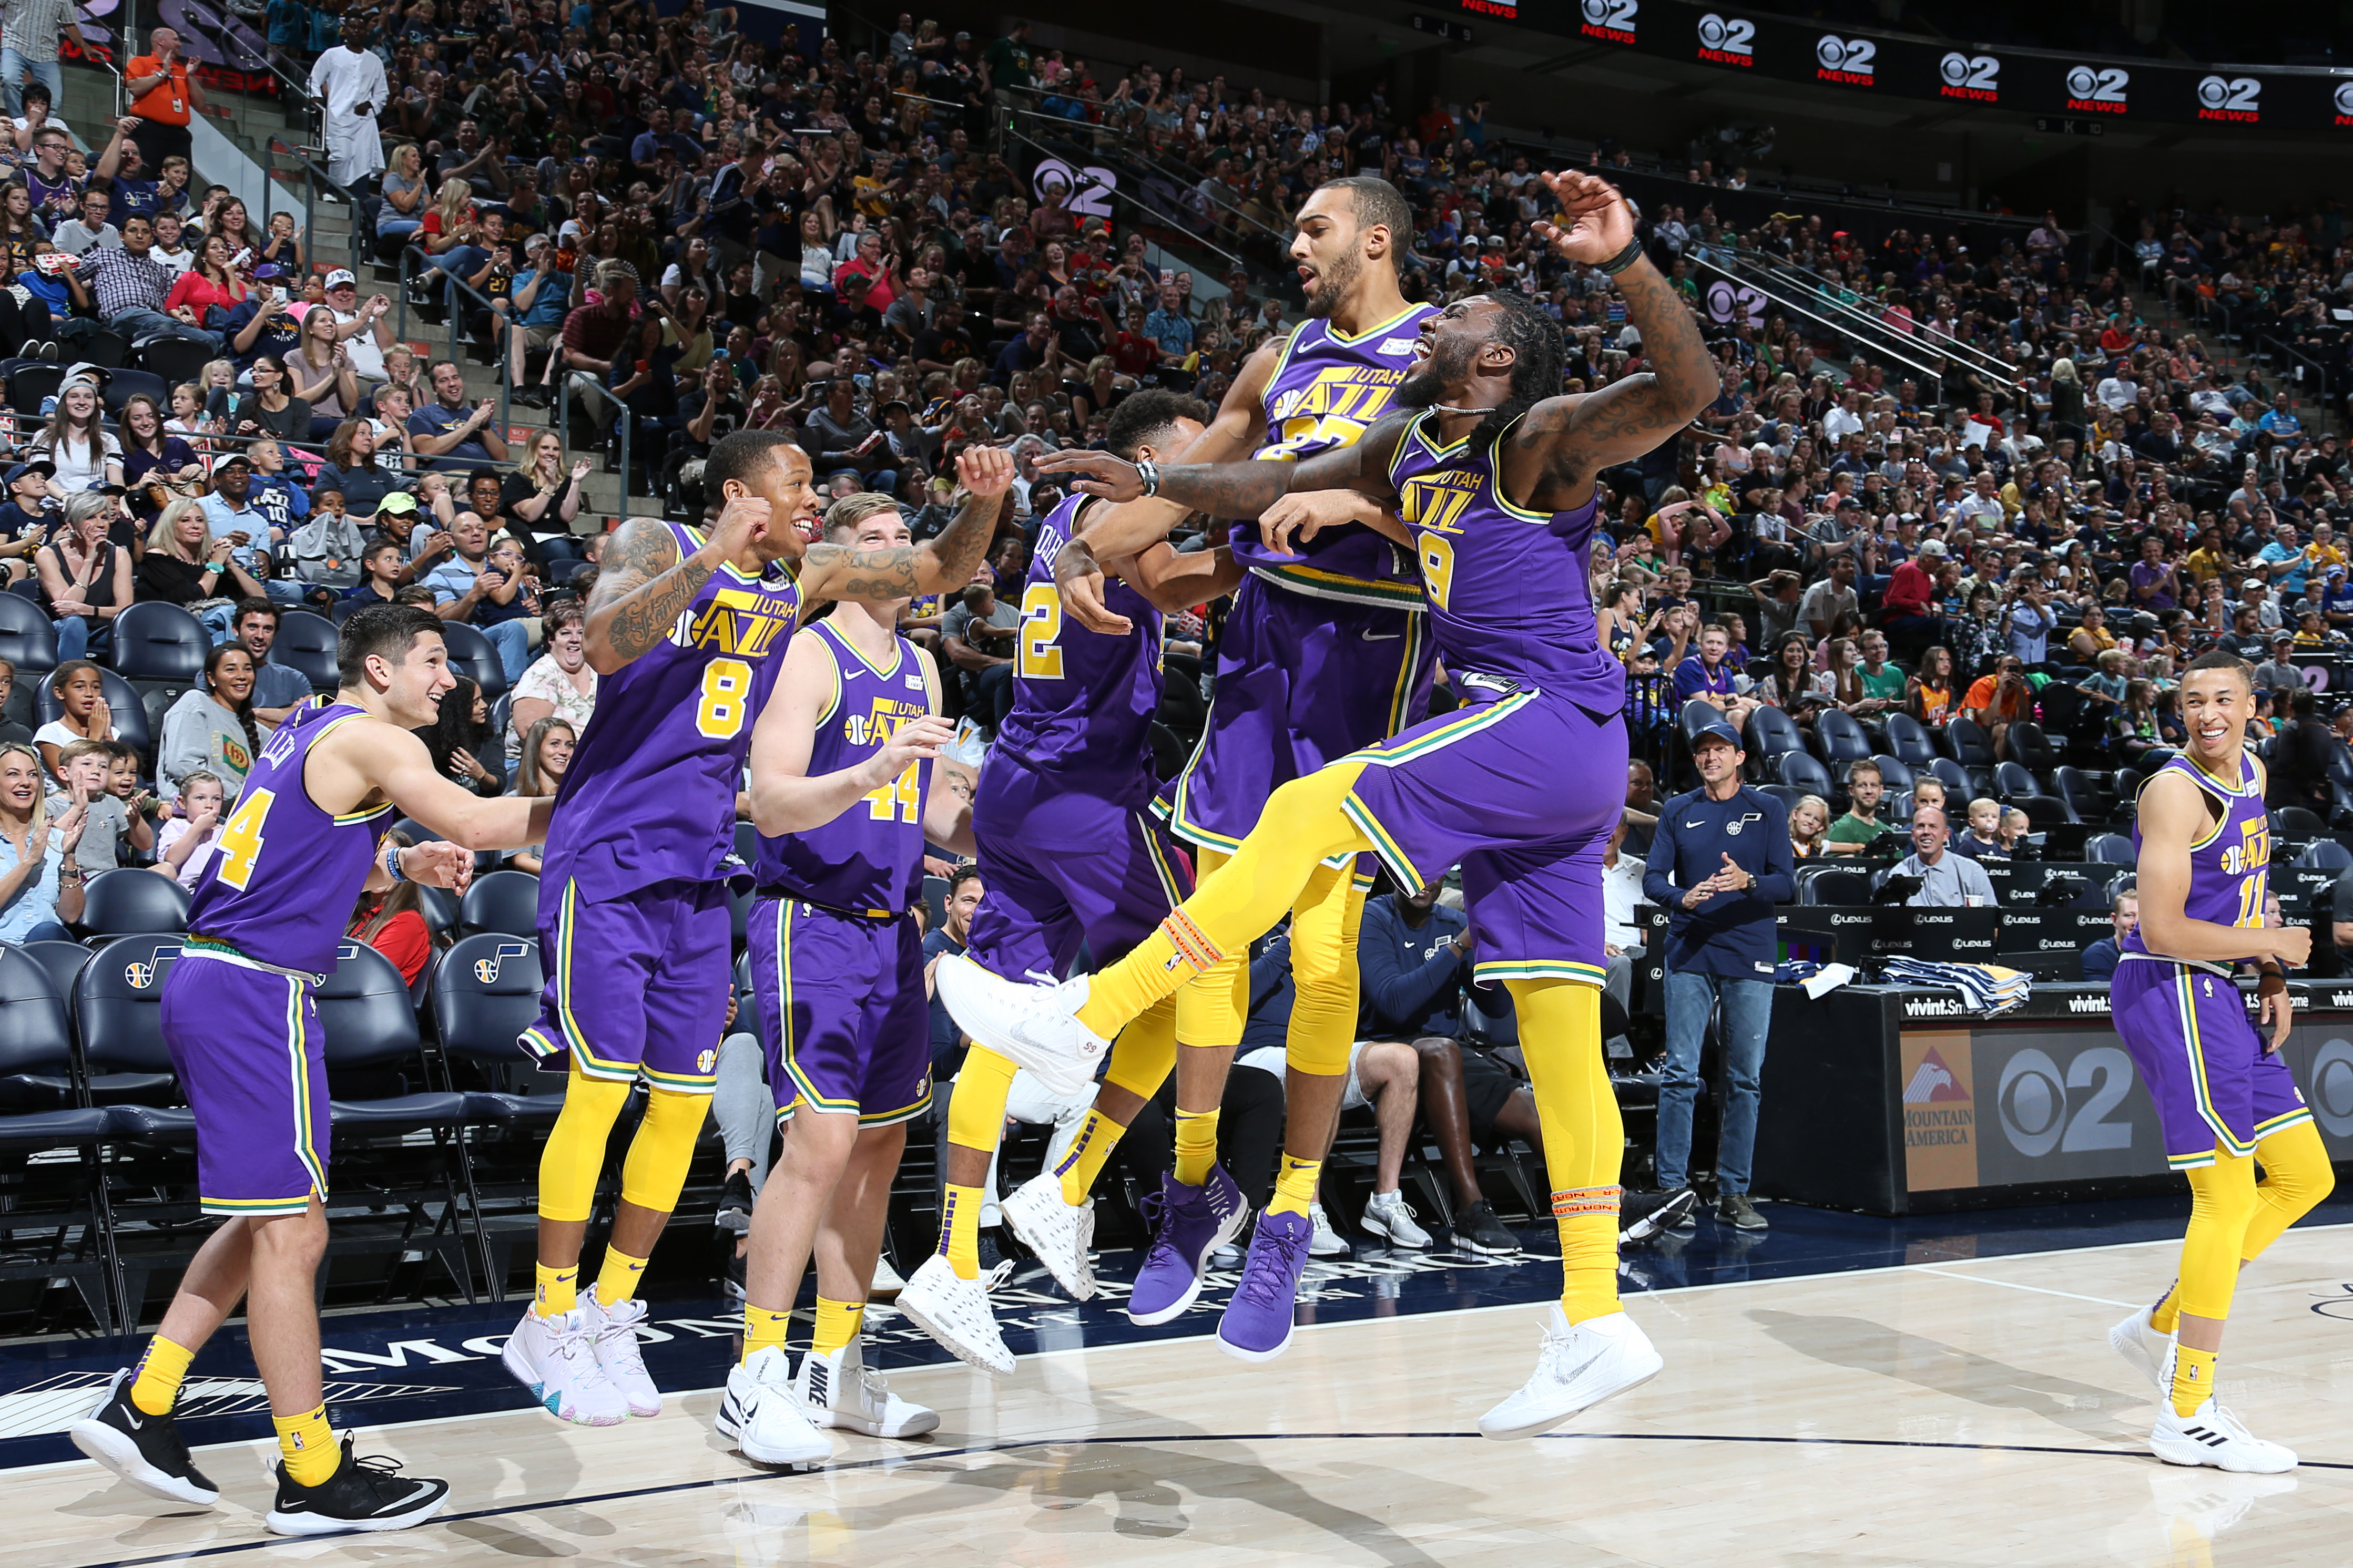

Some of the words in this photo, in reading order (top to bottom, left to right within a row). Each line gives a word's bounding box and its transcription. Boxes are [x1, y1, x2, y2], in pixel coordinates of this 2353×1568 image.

[1462, 0, 1517, 19] NEWS
[1606, 0, 1638, 32] 2
[1581, 23, 1636, 44] NEWS
[1723, 19, 1755, 55] 2
[1698, 48, 1754, 67] NEWS
[1841, 39, 1876, 74] 2
[1817, 68, 1874, 86] NEWS
[1965, 56, 2000, 90] 2
[1940, 85, 1998, 102] NEWS
[2093, 69, 2130, 103] 2
[2225, 78, 2262, 111] 2
[2067, 99, 2127, 114] NEWS
[2198, 109, 2259, 123] NEWS
[490, 277, 507, 292] 27
[1382, 341, 1394, 352] 5
[1357, 367, 1408, 385] UTAH
[1438, 470, 1485, 490] UTAH
[266, 506, 288, 524] 10
[761, 596, 798, 619] UTAH
[1015, 581, 1065, 680] 2
[695, 656, 755, 740] 8
[899, 702, 925, 718] UTAH
[215, 782, 277, 893] 4
[2233, 869, 2267, 929] 11
[2061, 1047, 2134, 1153] 2
[1904, 1109, 1972, 1128] MOUNTAIN
[1905, 1129, 1969, 1147] AMERICA
[756, 1355, 771, 1381] DOMINATE
[808, 1360, 828, 1409] NIKE
